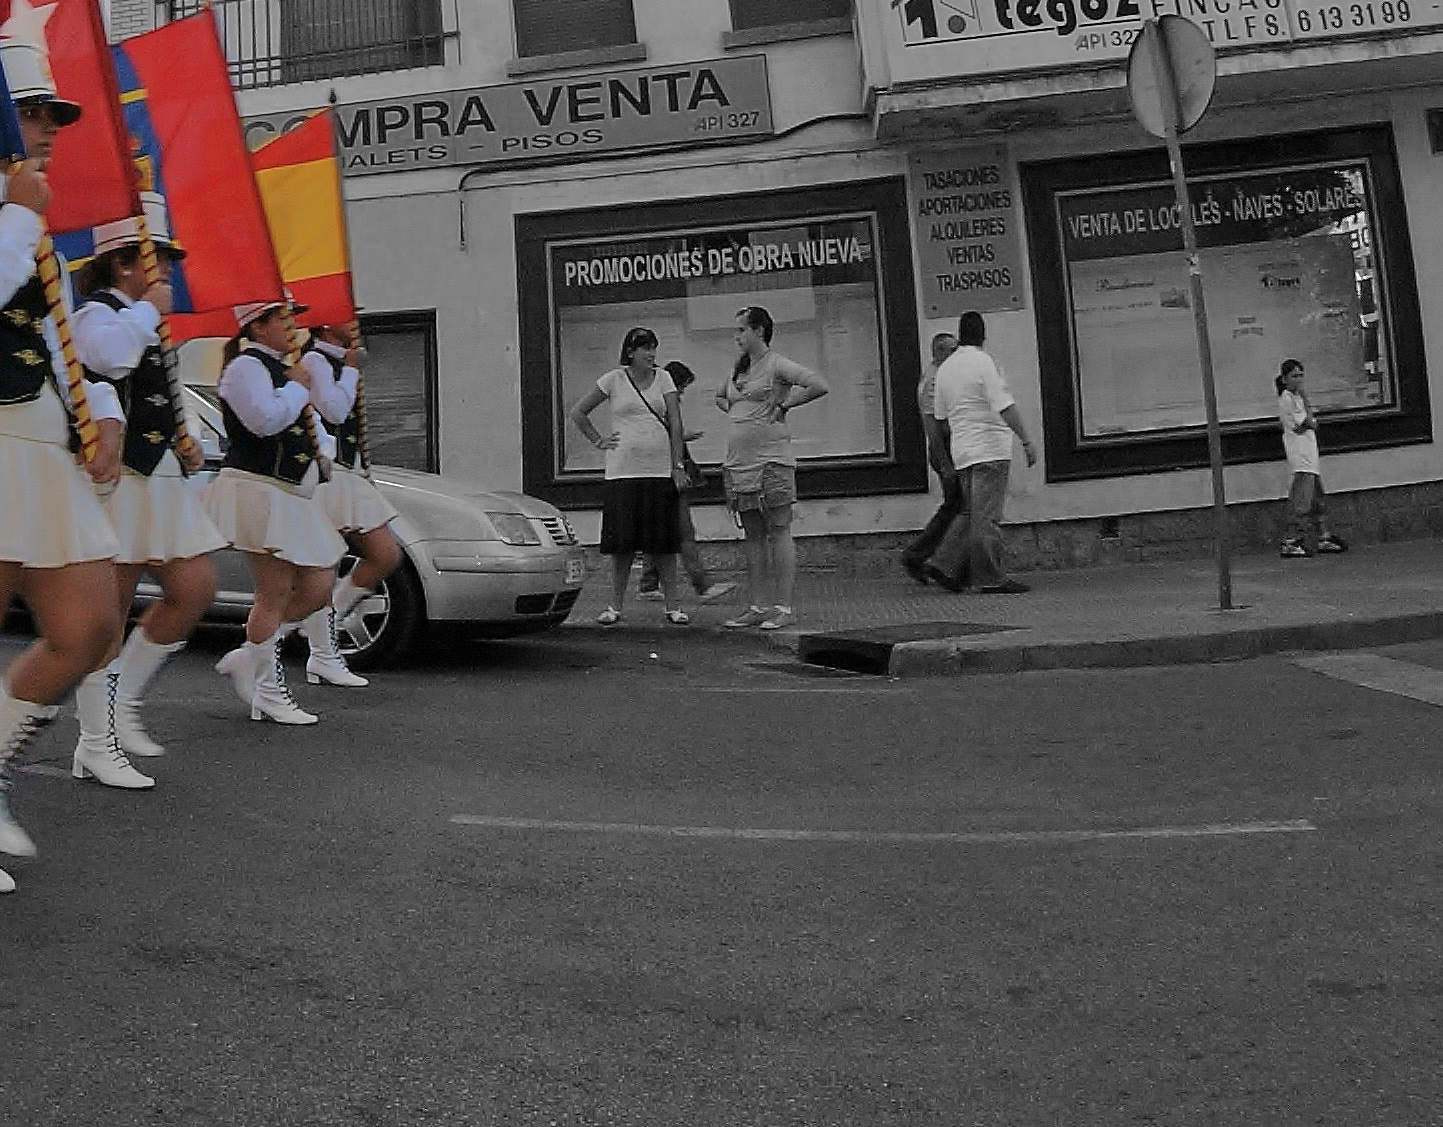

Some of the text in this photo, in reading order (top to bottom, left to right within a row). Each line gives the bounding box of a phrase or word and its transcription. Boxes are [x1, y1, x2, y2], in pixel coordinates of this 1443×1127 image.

[1202, 12, 1287, 43] TLFS.
[1076, 32, 1107, 53] API
[245, 68, 731, 154] CMPRA VENTA
[695, 111, 760, 132] API 327
[501, 128, 605, 153] PISOS
[923, 165, 999, 191] TASACIONES
[918, 190, 1012, 217] APORTACIONES
[1068, 212, 1122, 239] VENTA
[1124, 209, 1147, 233] DE
[1148, 200, 1221, 231] LOCLES
[1233, 193, 1284, 222] NAVES
[930, 217, 1006, 242] ALQUILERES
[565, 236, 863, 287] PROMOCIONES DE OBRA NUEVA
[947, 243, 996, 264] VENTAS
[936, 267, 1012, 293] TRASPASOS
